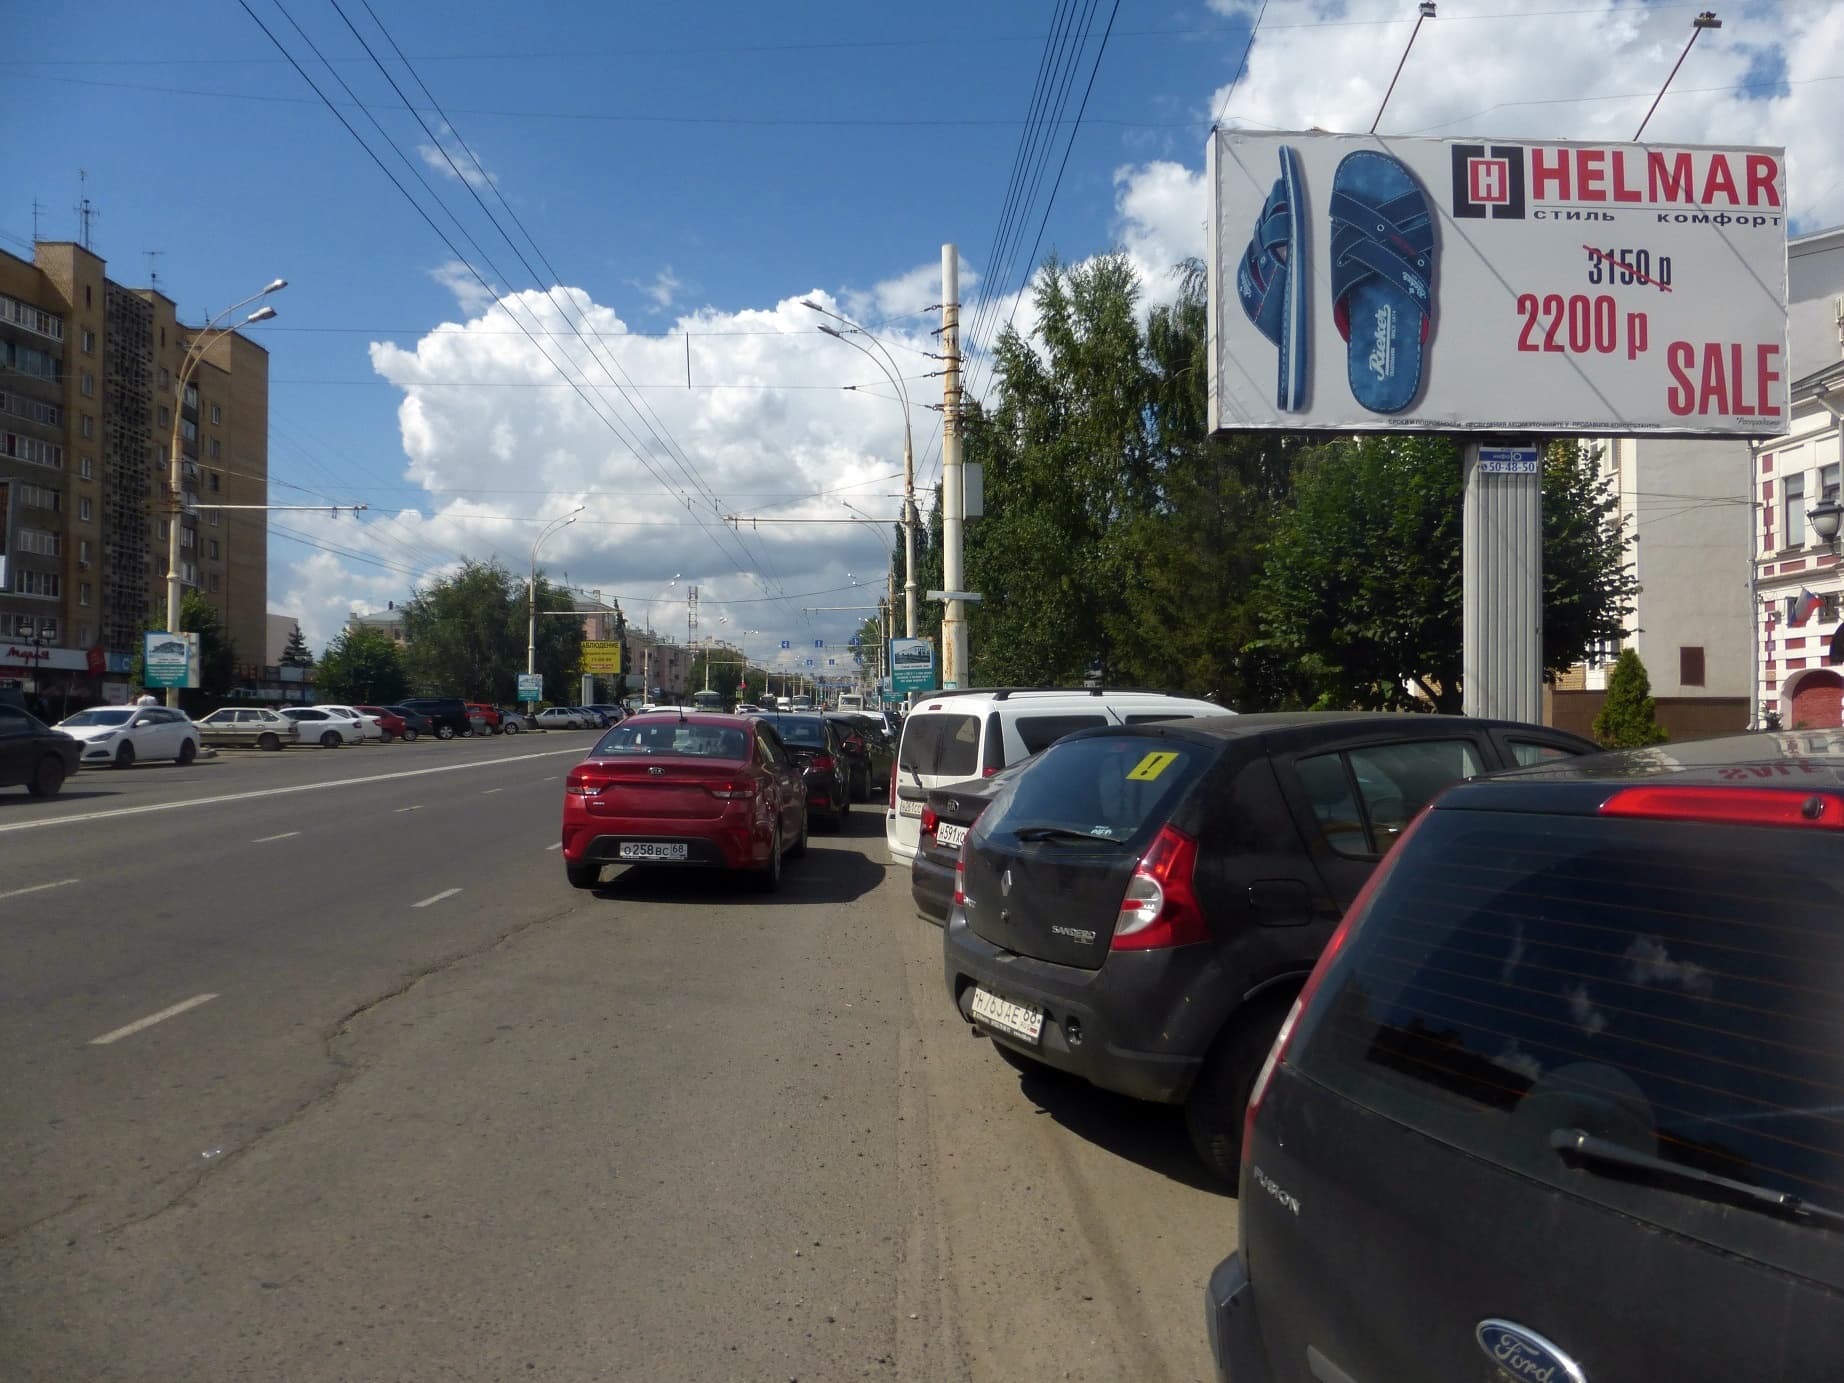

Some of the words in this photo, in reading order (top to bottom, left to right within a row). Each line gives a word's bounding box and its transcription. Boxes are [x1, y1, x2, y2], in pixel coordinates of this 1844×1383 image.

[1531, 148, 1781, 207] HELMAR
[1533, 210, 1616, 222] стиль
[1657, 212, 1782, 228] комфорт
[1587, 248, 1650, 286] 3150
[1516, 293, 1617, 353] 2200
[1627, 311, 1648, 360] р
[1667, 341, 1781, 416] SALE
[1489, 462, 1535, 472] 50-48-50
[672, 844, 684, 854] 68
[1494, 1334, 1555, 1382] Ford
